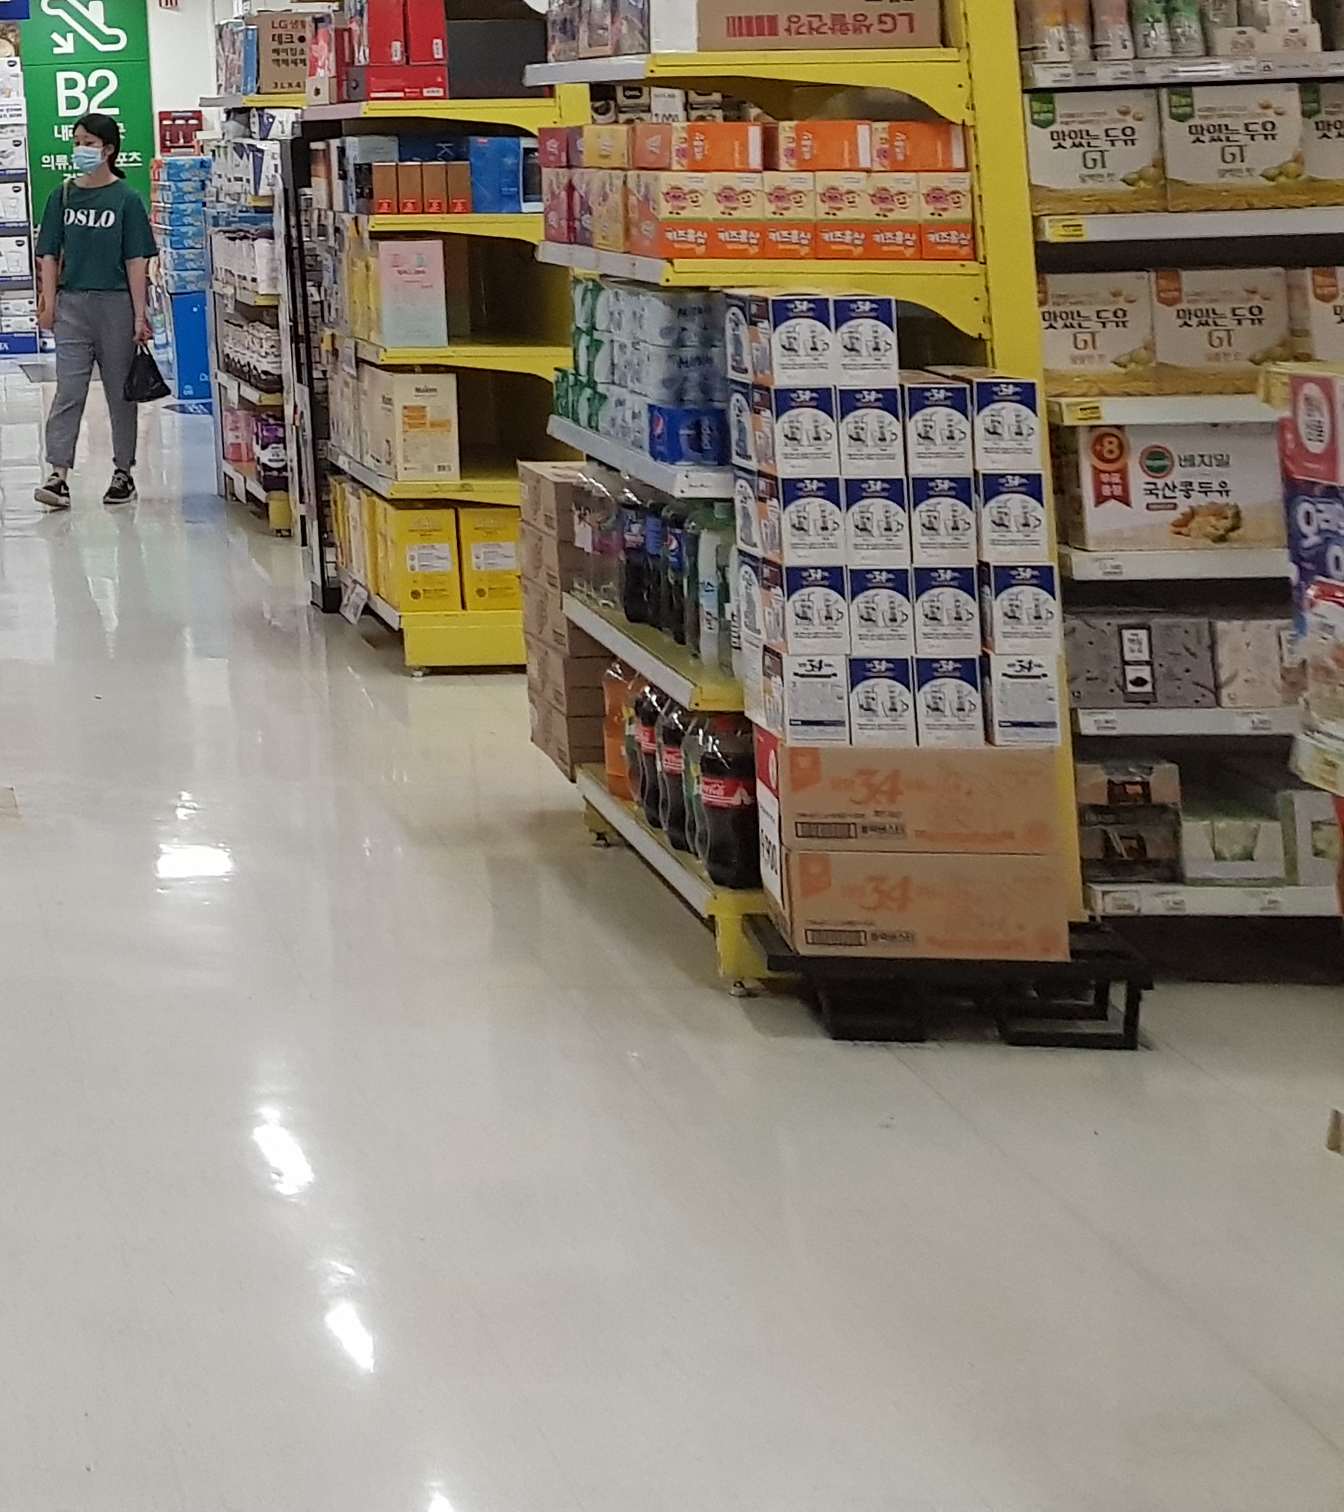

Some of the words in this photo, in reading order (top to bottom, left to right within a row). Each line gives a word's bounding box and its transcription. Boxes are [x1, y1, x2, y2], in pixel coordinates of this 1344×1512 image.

[782, 12, 874, 38] 생활건강
[879, 11, 916, 35] LG
[56, 69, 121, 118] B2
[1049, 126, 1103, 148] 맛있는
[1104, 125, 1139, 147] 두유
[1187, 122, 1242, 145] 맛있는
[1243, 120, 1278, 143] 두유
[64, 209, 116, 229] OSLO
[1175, 305, 1229, 328] 맛있는
[1230, 304, 1266, 326] 두유
[1177, 452, 1231, 470] 베지밀
[1142, 480, 1232, 500] 국산콩두유
